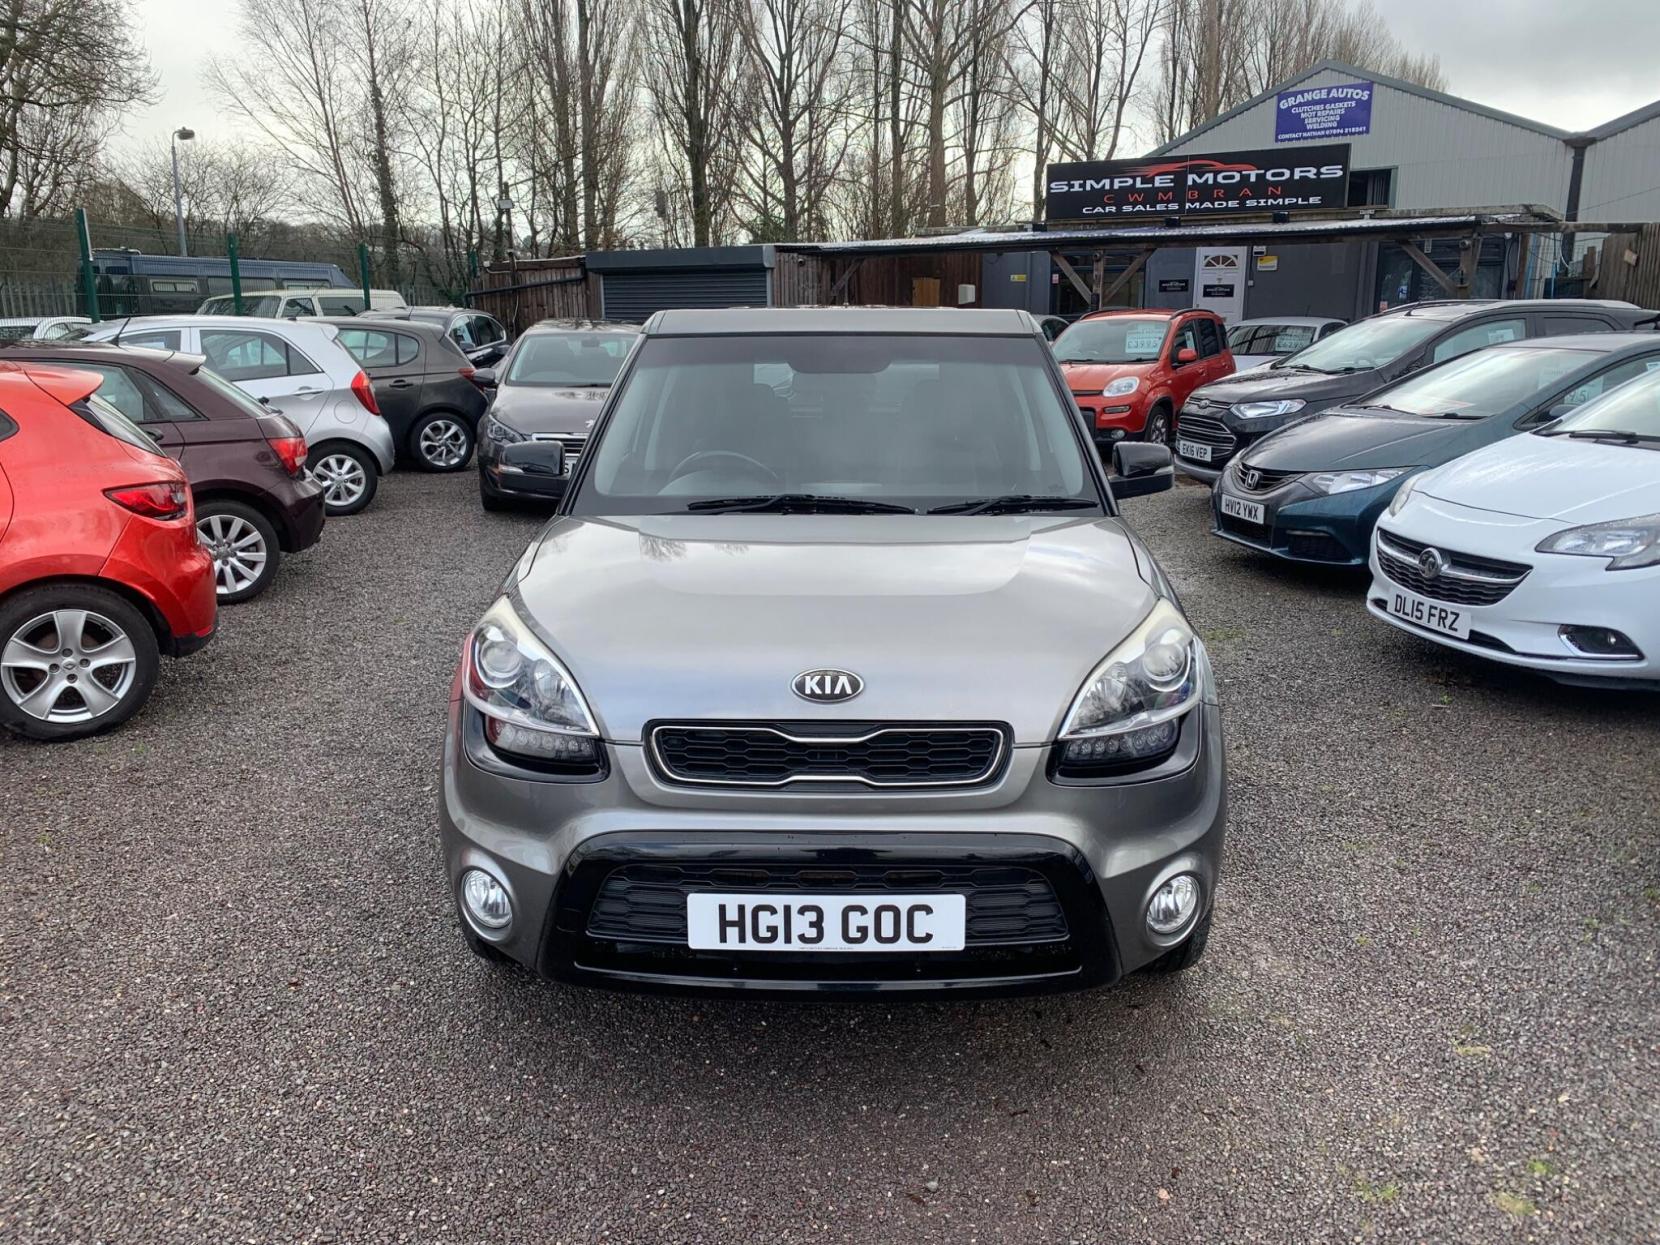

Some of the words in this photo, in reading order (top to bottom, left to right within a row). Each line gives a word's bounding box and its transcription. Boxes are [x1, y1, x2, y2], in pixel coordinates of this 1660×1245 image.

[1279, 89, 1328, 109] GRANGE
[1329, 88, 1370, 101] AUTOS
[1291, 104, 1324, 114] CLUTCHES
[1325, 101, 1356, 111] GASKETS
[1301, 111, 1316, 119] MOT
[1317, 108, 1345, 117] REPAIRS
[1305, 115, 1340, 124] SERVICING
[1306, 121, 1337, 130] WELDING
[1278, 132, 1302, 140] CONTACT
[1302, 129, 1325, 138] NATHAN
[1050, 174, 1175, 193] SIMPLE
[1187, 165, 1344, 185] MOTORS
[1103, 186, 1281, 203] CWMBRAN
[1082, 206, 1117, 214] CAR
[1122, 203, 1179, 212] SALES
[1185, 200, 1239, 209] MADE
[1245, 196, 1322, 207] SIMPLE
[1182, 443, 1195, 457] EK16
[1195, 446, 1208, 459] VEP
[1225, 498, 1241, 516] HV12
[1242, 503, 1259, 521] YWX
[1394, 593, 1425, 621] DL15
[1427, 604, 1460, 633] FRZ
[804, 675, 853, 695] KIA
[718, 903, 824, 945] HG13
[841, 903, 934, 944] GOC
